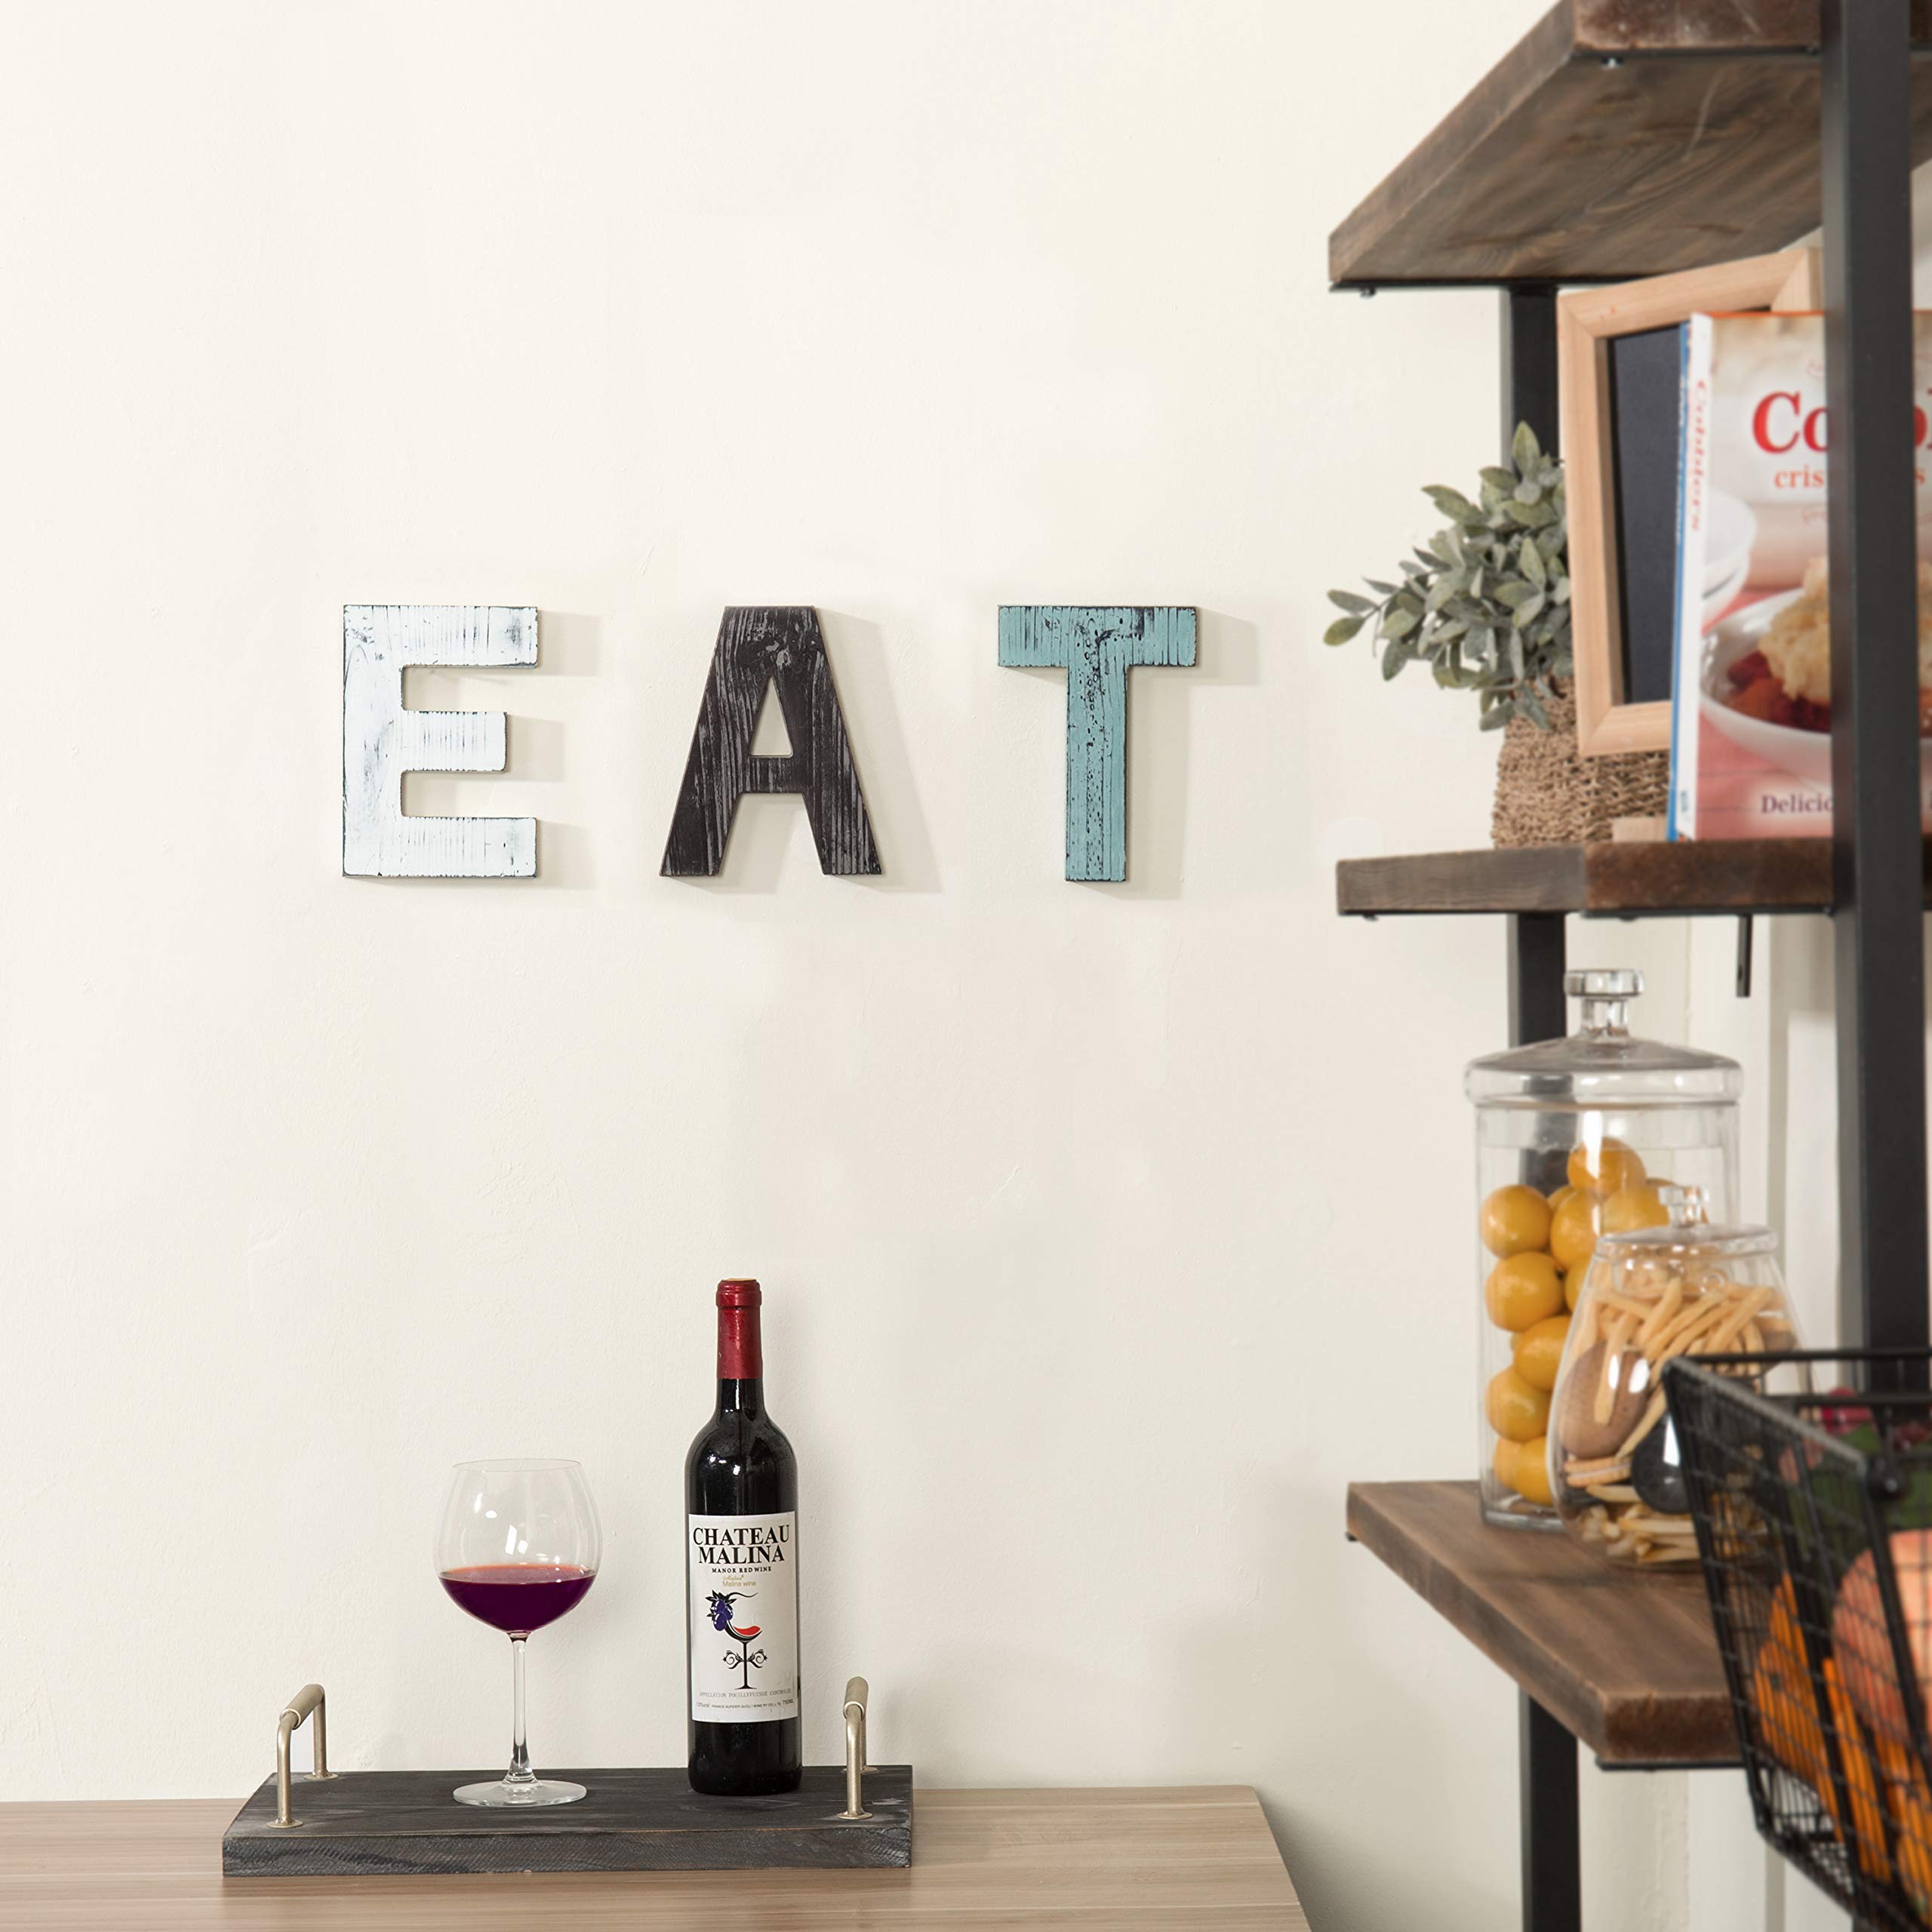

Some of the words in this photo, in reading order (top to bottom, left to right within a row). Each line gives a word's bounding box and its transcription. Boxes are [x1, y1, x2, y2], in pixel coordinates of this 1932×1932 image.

[343, 605, 1198, 881] EAT
[693, 1524, 789, 1546] CHATEAU
[698, 1545, 785, 1564] MALINA
